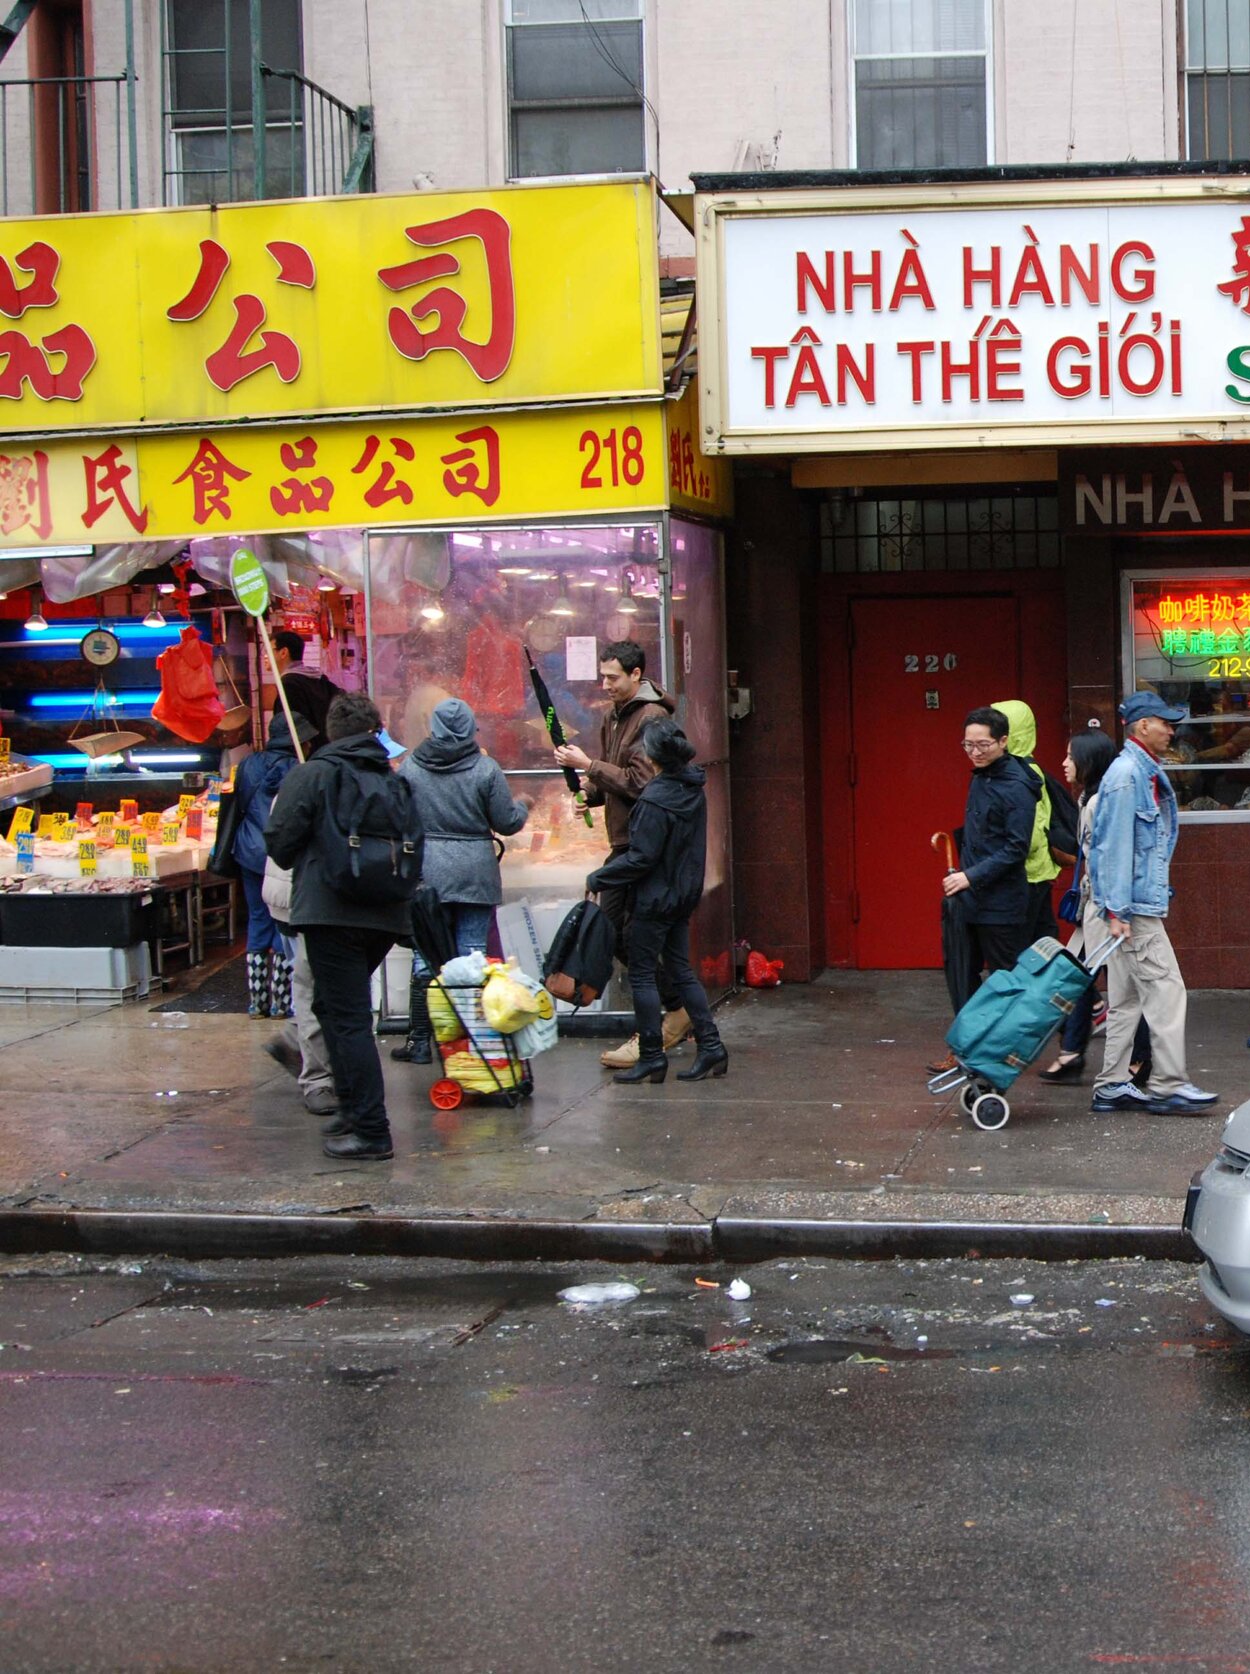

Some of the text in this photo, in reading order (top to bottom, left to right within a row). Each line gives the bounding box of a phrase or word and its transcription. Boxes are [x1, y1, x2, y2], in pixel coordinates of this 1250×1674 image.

[796, 225, 1156, 313] NHÀ HÀNG
[751, 325, 876, 408] TÂN
[579, 425, 645, 489] 218
[1075, 459, 1202, 525] NHÀ
